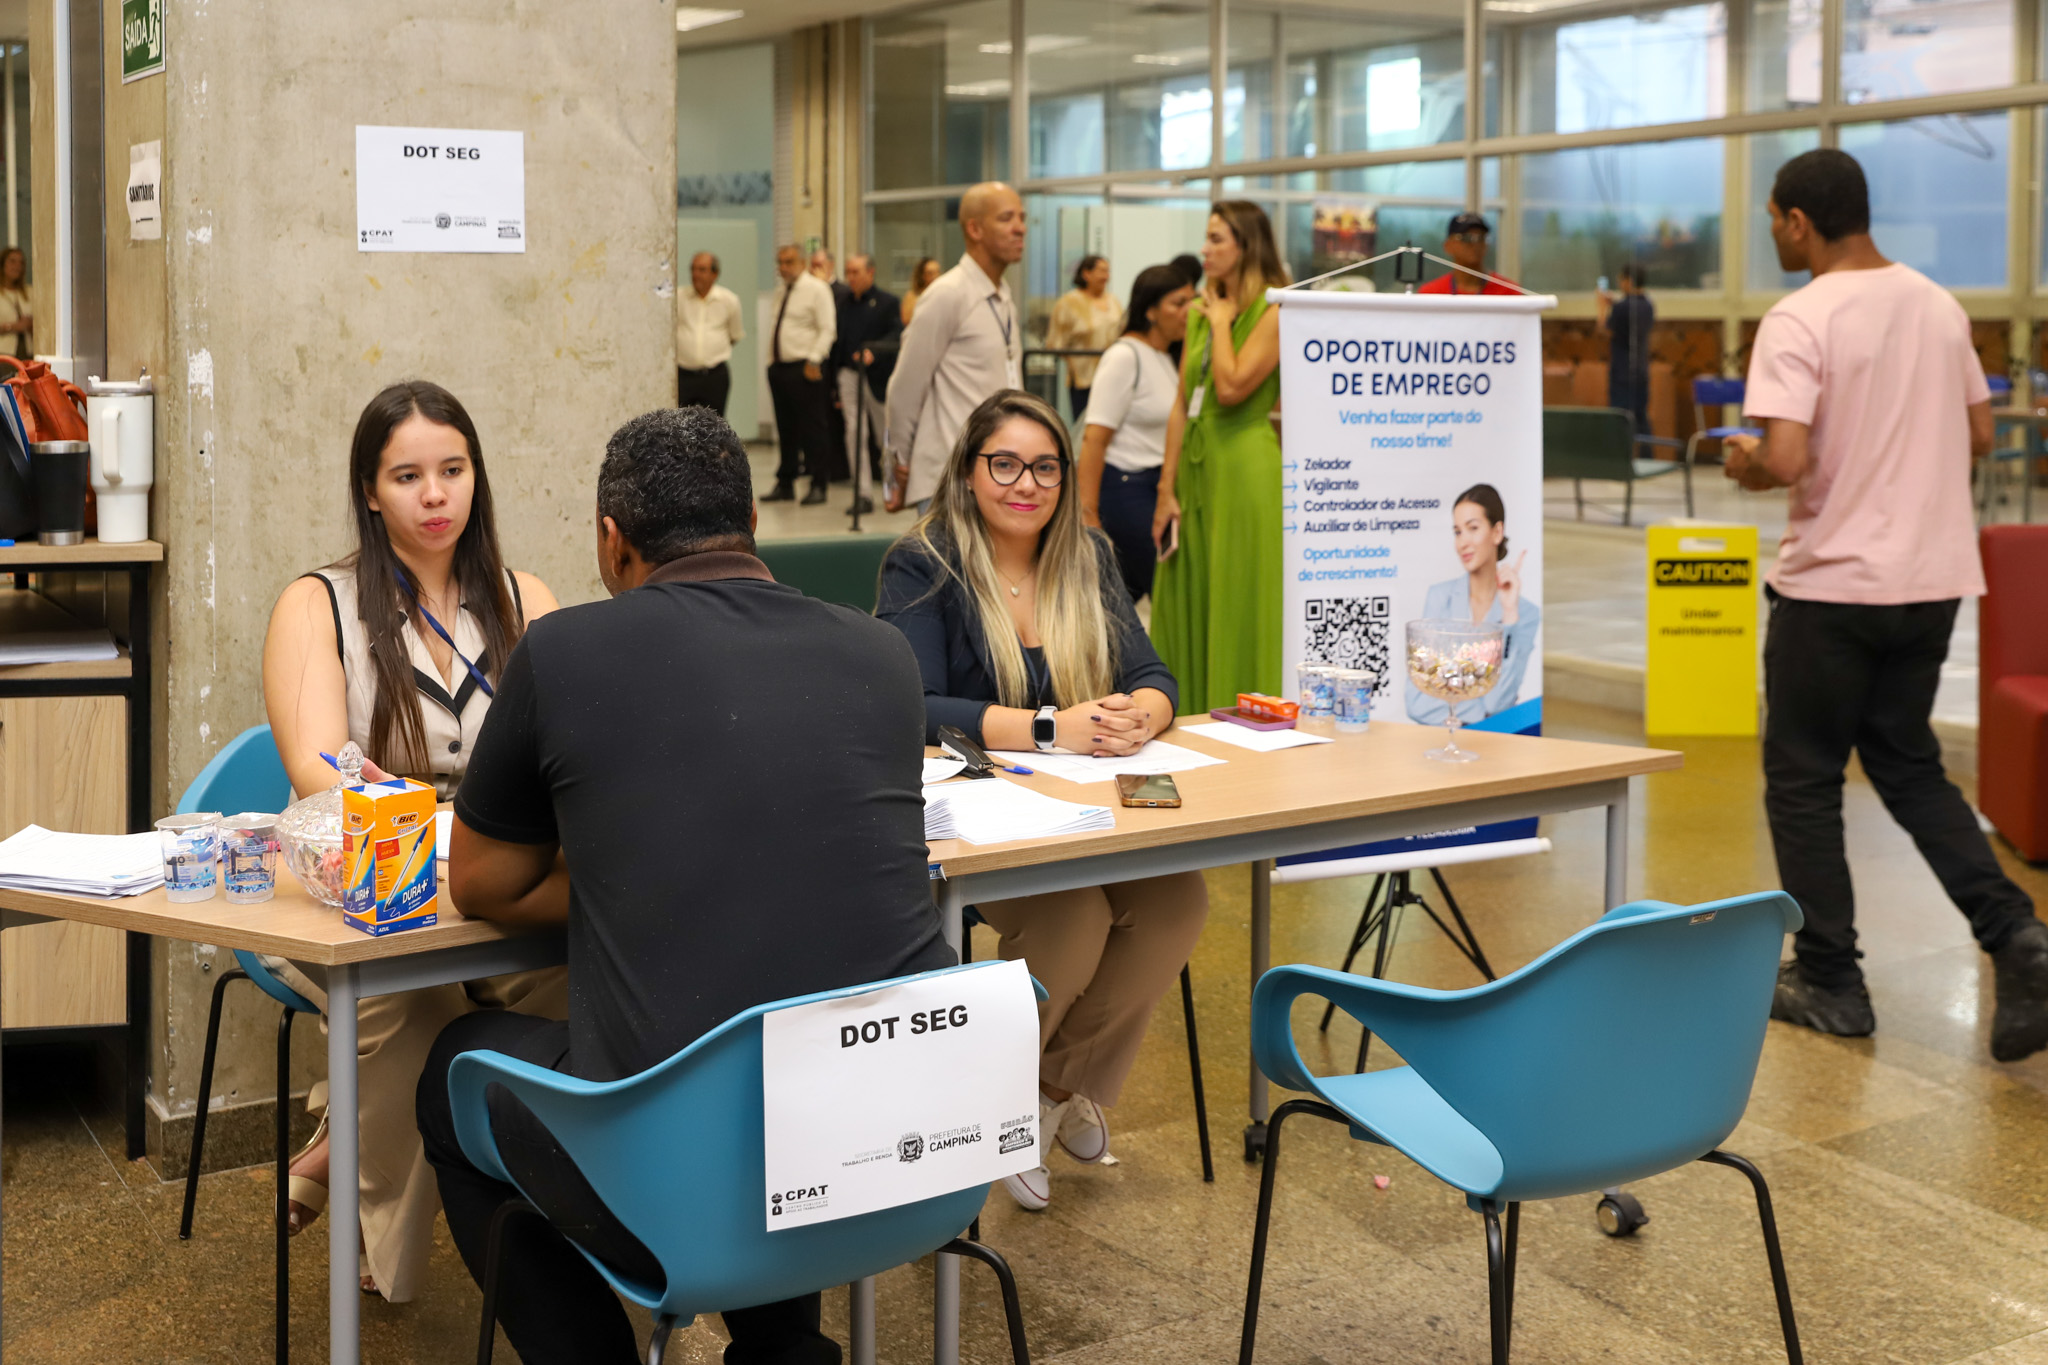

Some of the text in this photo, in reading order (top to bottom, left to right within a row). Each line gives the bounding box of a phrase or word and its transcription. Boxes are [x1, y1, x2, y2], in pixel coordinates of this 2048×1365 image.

[125, 11, 148, 51] SAÍDA
[403, 145, 481, 160] DOT SEG
[1303, 339, 1517, 364] OPORTUNIDADES
[1332, 373, 1491, 395] DE EMPREGO
[1339, 409, 1483, 428] Venha fazer parte do
[1371, 433, 1452, 448] nosso time!
[1304, 458, 1351, 470] Zelador
[1304, 478, 1359, 495] Vigilante
[1303, 498, 1440, 512] Controlador de Acesso
[1304, 518, 1420, 533] Auxiliar de Limpeza
[1303, 545, 1391, 563] Oportunidade
[1298, 566, 1398, 581] de crescimento!
[1657, 562, 1748, 583] CAUTION
[1680, 607, 1722, 620] Under
[1659, 626, 1746, 637] maintenance
[841, 1004, 969, 1048] DOT SEG
[929, 1123, 982, 1141] PREFEITURA DE
[929, 1132, 982, 1152] CAMPINAS
[842, 1157, 870, 1167] TRABALHO
[875, 1152, 893, 1161] RENDA
[785, 1184, 829, 1201] CPAT
